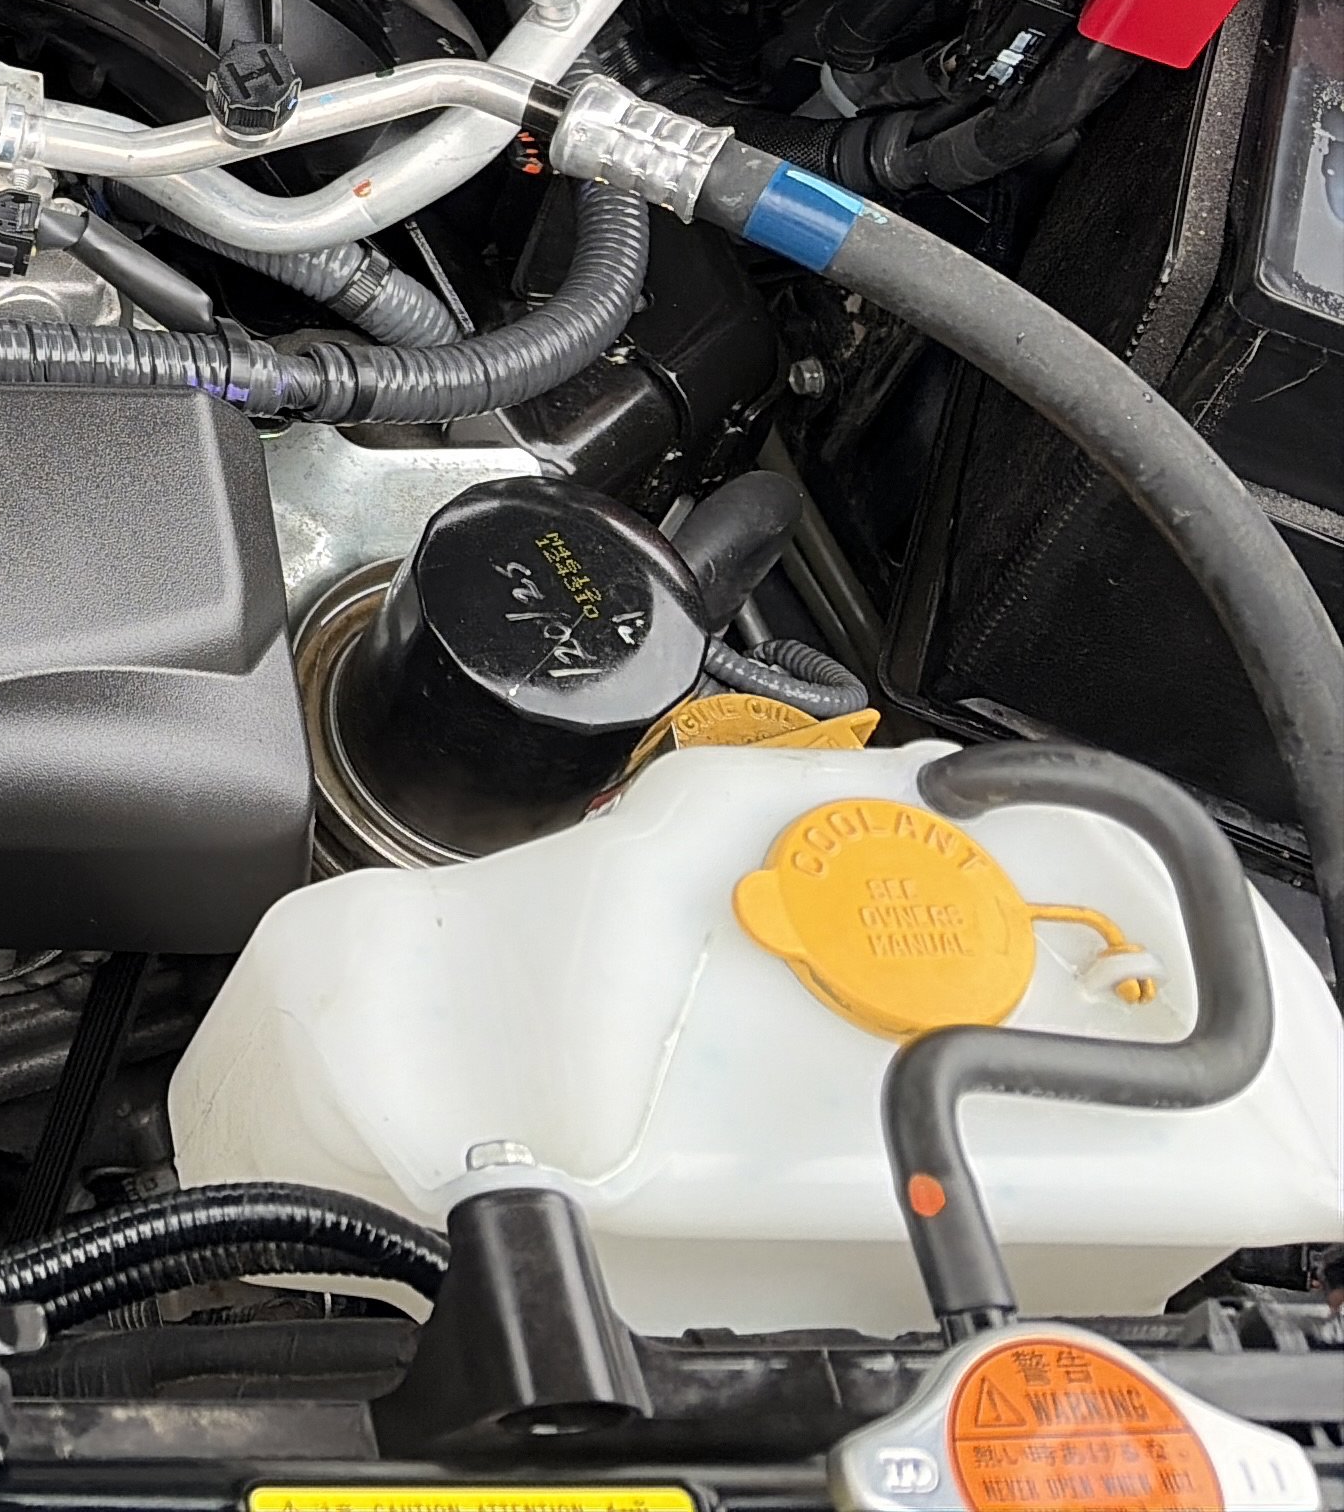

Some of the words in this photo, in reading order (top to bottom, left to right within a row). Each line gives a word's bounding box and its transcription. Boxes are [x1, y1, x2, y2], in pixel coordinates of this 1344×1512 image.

[225, 48, 285, 100] H
[745, 698, 796, 731] OIL
[790, 807, 987, 877] COOLANT
[865, 878, 919, 901] SEE
[868, 932, 975, 958] MANUAL
[1013, 1349, 1093, 1386] 警告
[1026, 1388, 1149, 1426] WARNING
[981, 1478, 1040, 1501] NEVER
[1046, 1477, 1095, 1499] OPEN
[1100, 1473, 1153, 1497] WHEN
[1158, 1469, 1194, 1495] HOT
